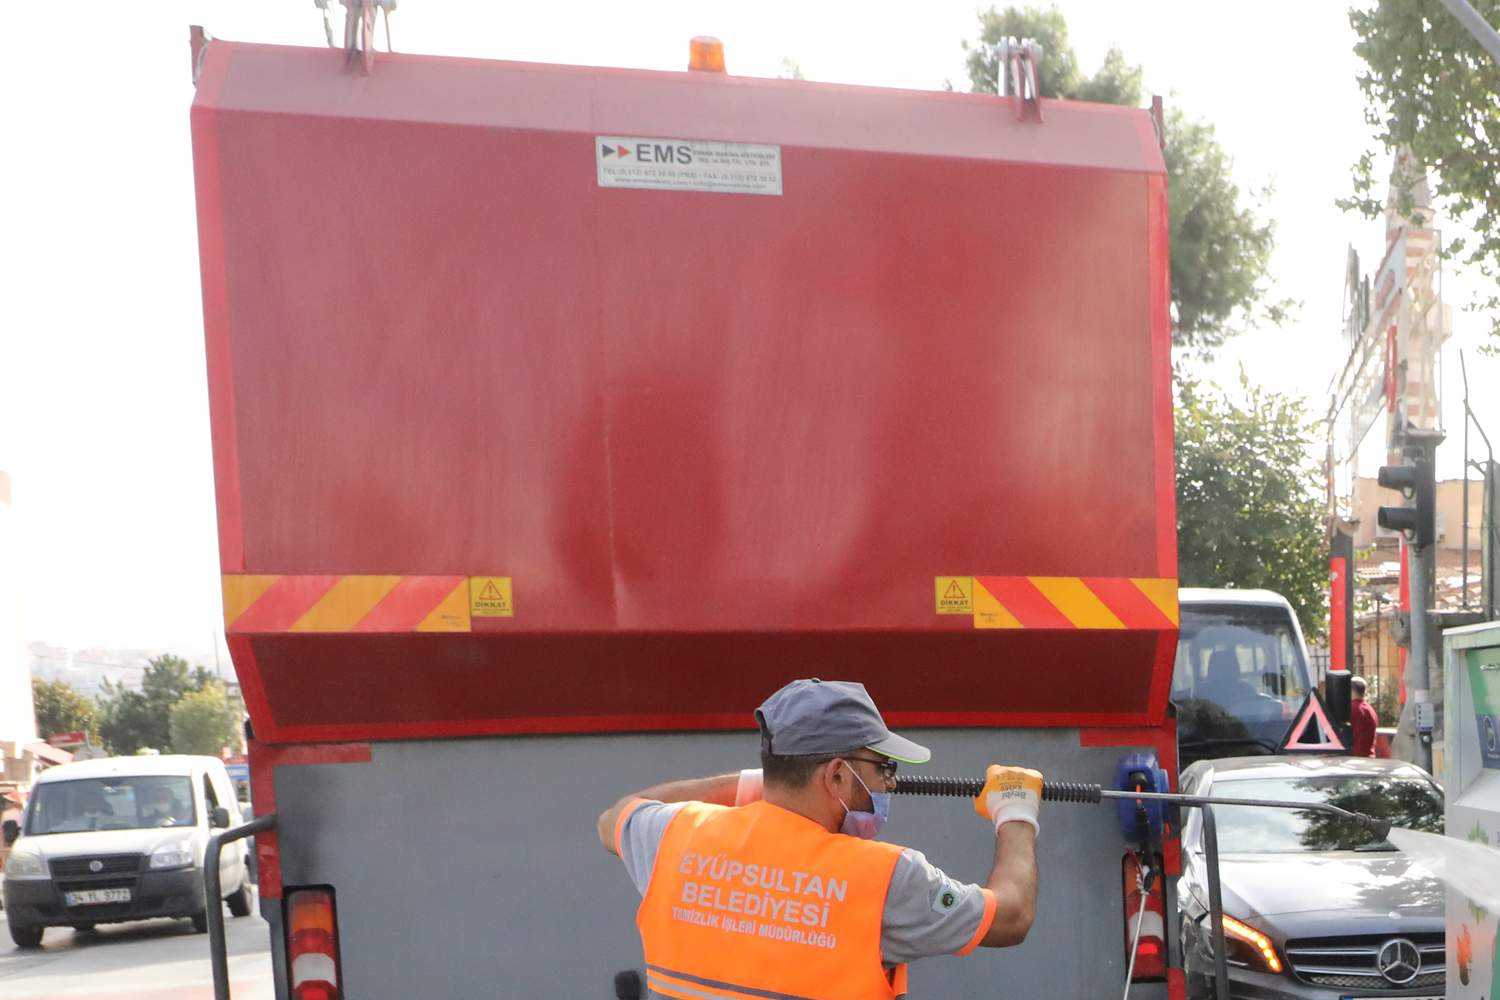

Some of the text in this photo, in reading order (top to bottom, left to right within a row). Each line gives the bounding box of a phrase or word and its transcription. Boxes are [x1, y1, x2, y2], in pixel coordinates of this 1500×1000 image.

[636, 143, 692, 165] EMS
[680, 852, 848, 902] EYÜPSULTAN
[681, 882, 831, 928] BELEDİYESİ
